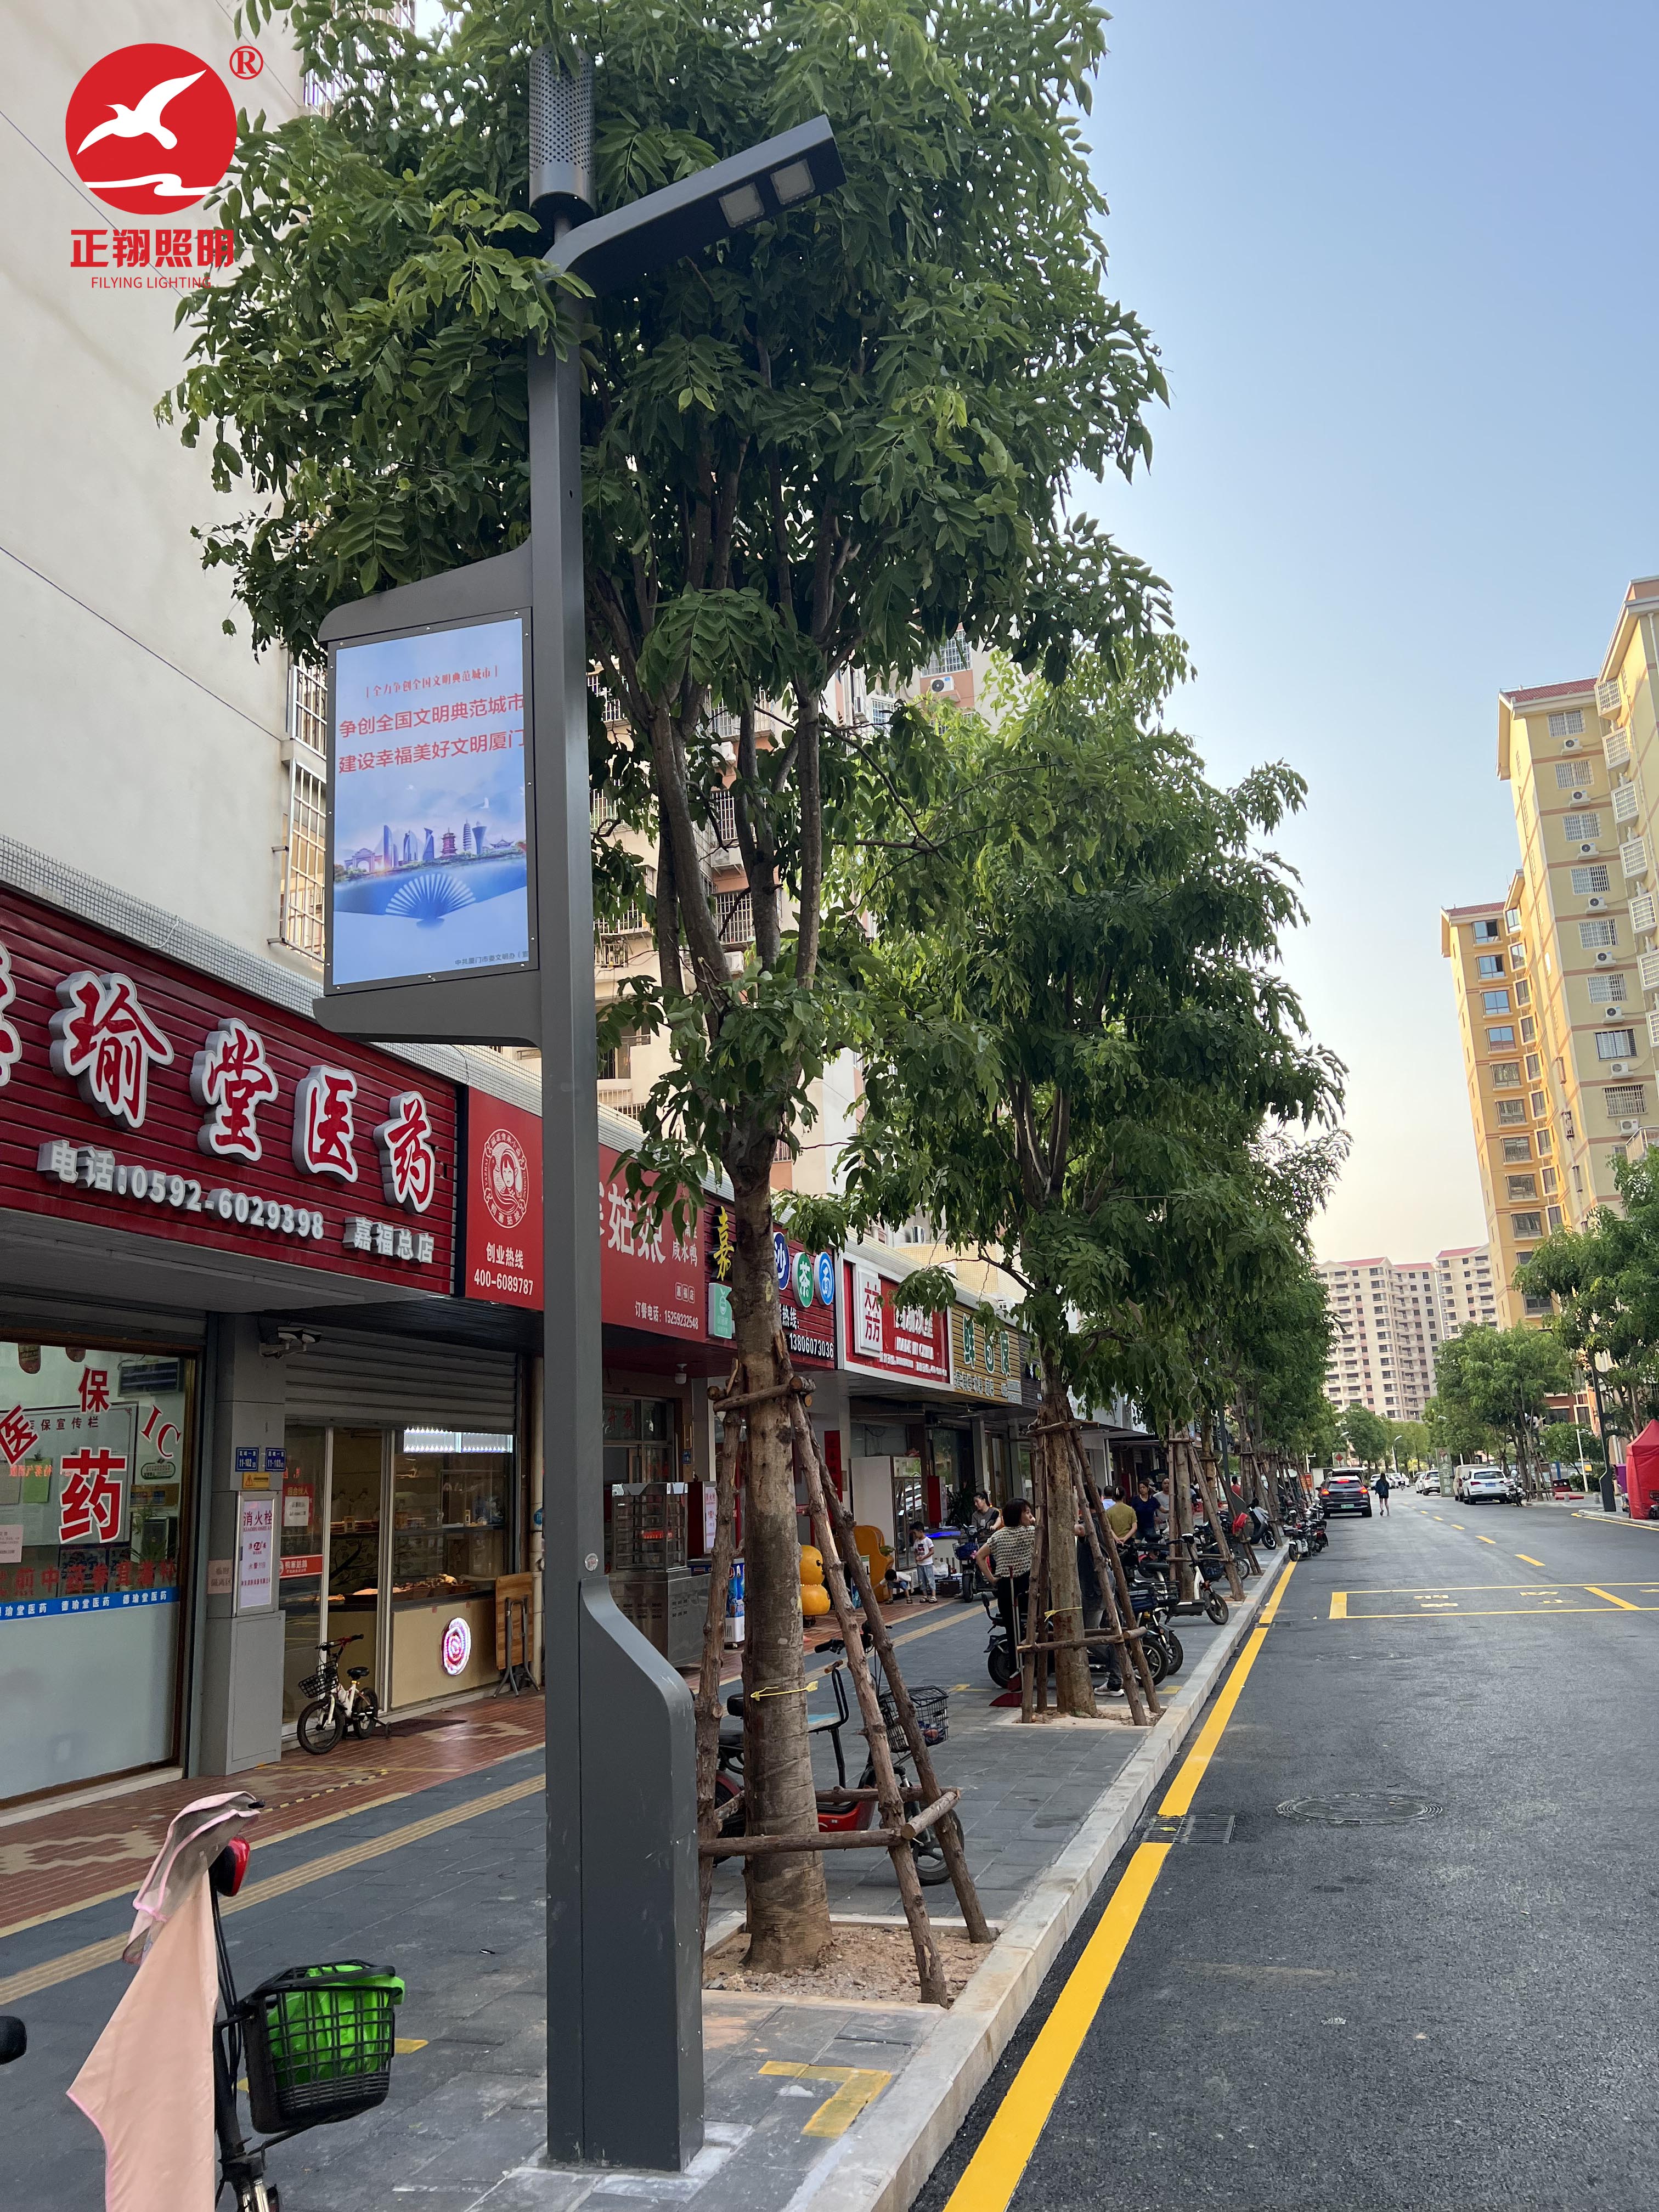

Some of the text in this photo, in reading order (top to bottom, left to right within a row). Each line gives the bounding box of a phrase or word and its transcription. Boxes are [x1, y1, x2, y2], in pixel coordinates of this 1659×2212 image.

[373, 666, 492, 697] 全力争创全国文明典范城市
[339, 693, 524, 738] 争创全国文明典范城市
[338, 729, 525, 774] 建设幸福美好文明厦门
[0, 940, 436, 1213] 瑜堂医药
[346, 1216, 435, 1264] 嘉福总店
[486, 1242, 524, 1270] 创业热线
[474, 1268, 534, 1295] 400-6089787
[789, 1332, 834, 1358] 13806073036
[60, 1447, 127, 1543] 药
[244, 1510, 273, 1526] 消火栓
[0, 1602, 48, 1617] 瑜堂医药
